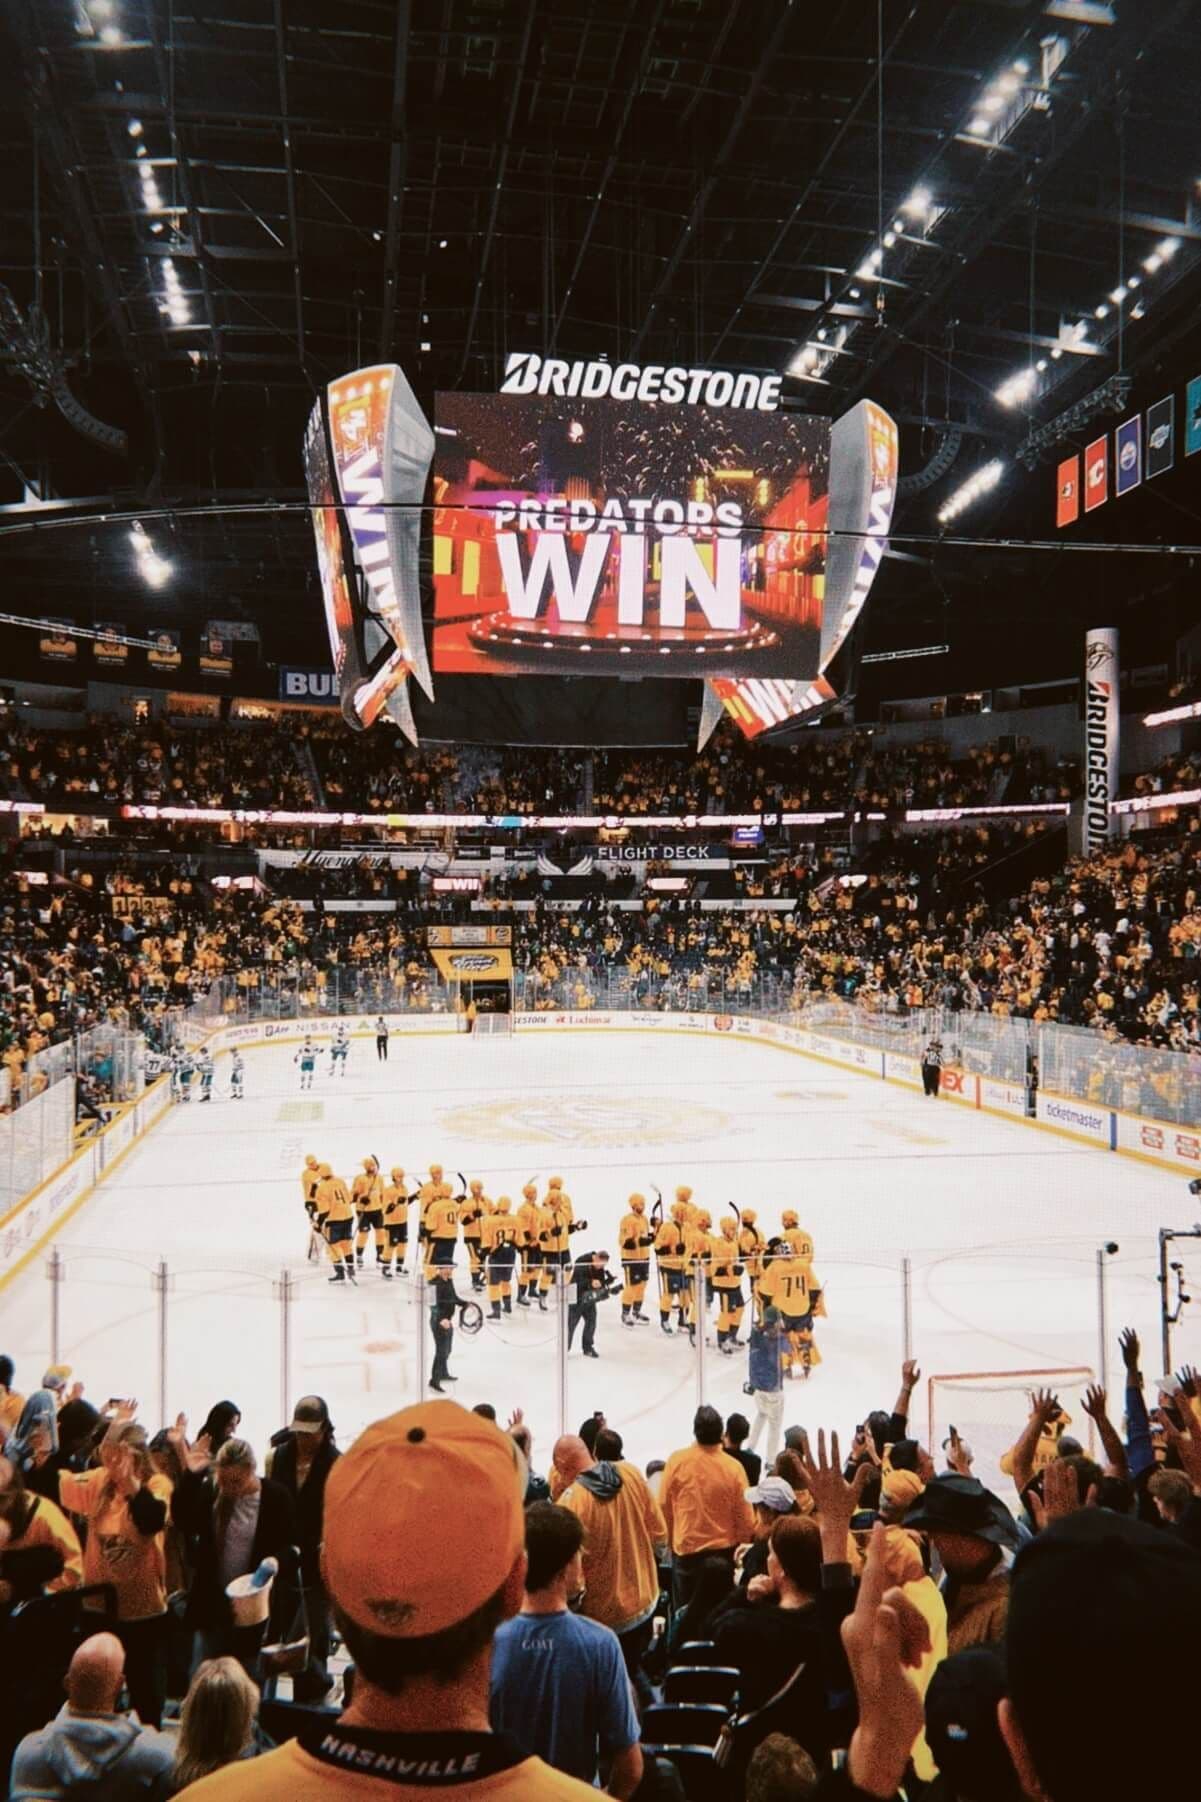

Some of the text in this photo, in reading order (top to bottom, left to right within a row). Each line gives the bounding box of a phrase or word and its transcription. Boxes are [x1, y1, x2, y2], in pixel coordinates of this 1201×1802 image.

[500, 353, 783, 411] BRIDGESTONE
[495, 498, 744, 537] PREDATORS
[496, 532, 742, 629] WIN
[286, 672, 341, 696] BU
[598, 846, 709, 860] FLIGHT DECK
[1047, 1103, 1103, 1130] ticketmaster
[780, 1275, 806, 1298] 74
[320, 1733, 482, 1778] NASHVILLE
